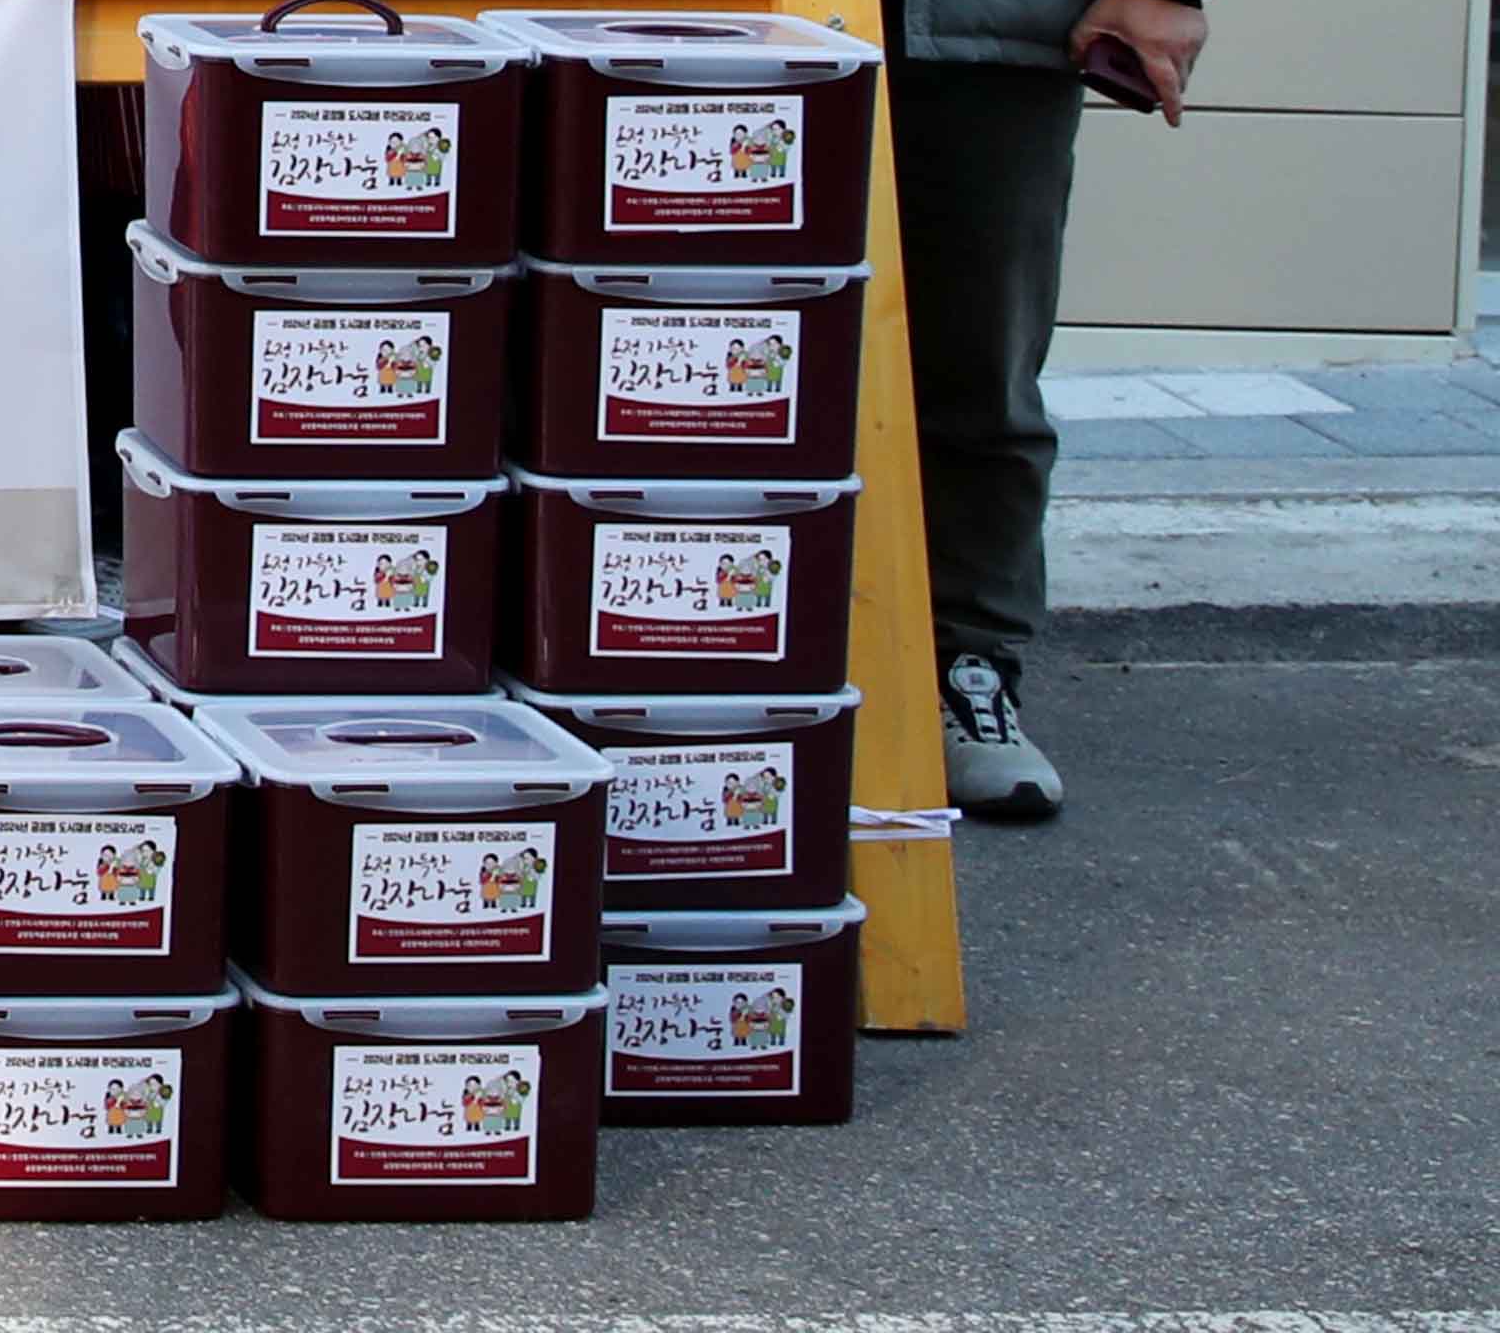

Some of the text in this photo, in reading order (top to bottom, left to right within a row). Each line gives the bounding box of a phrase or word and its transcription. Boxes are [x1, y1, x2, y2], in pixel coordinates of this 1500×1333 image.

[270, 154, 379, 191] 김장나눔
[615, 148, 724, 185] 김장나눔
[262, 363, 370, 399] 김장나눔
[610, 361, 719, 397] 김장나눔
[260, 576, 367, 612] 김장나눔
[601, 576, 709, 612] 김장나눔
[611, 797, 717, 835] 김장나눔
[361, 877, 472, 916] 김장나눔
[616, 1015, 723, 1052] 김장나눔
[342, 1099, 456, 1138] 김장나눔
